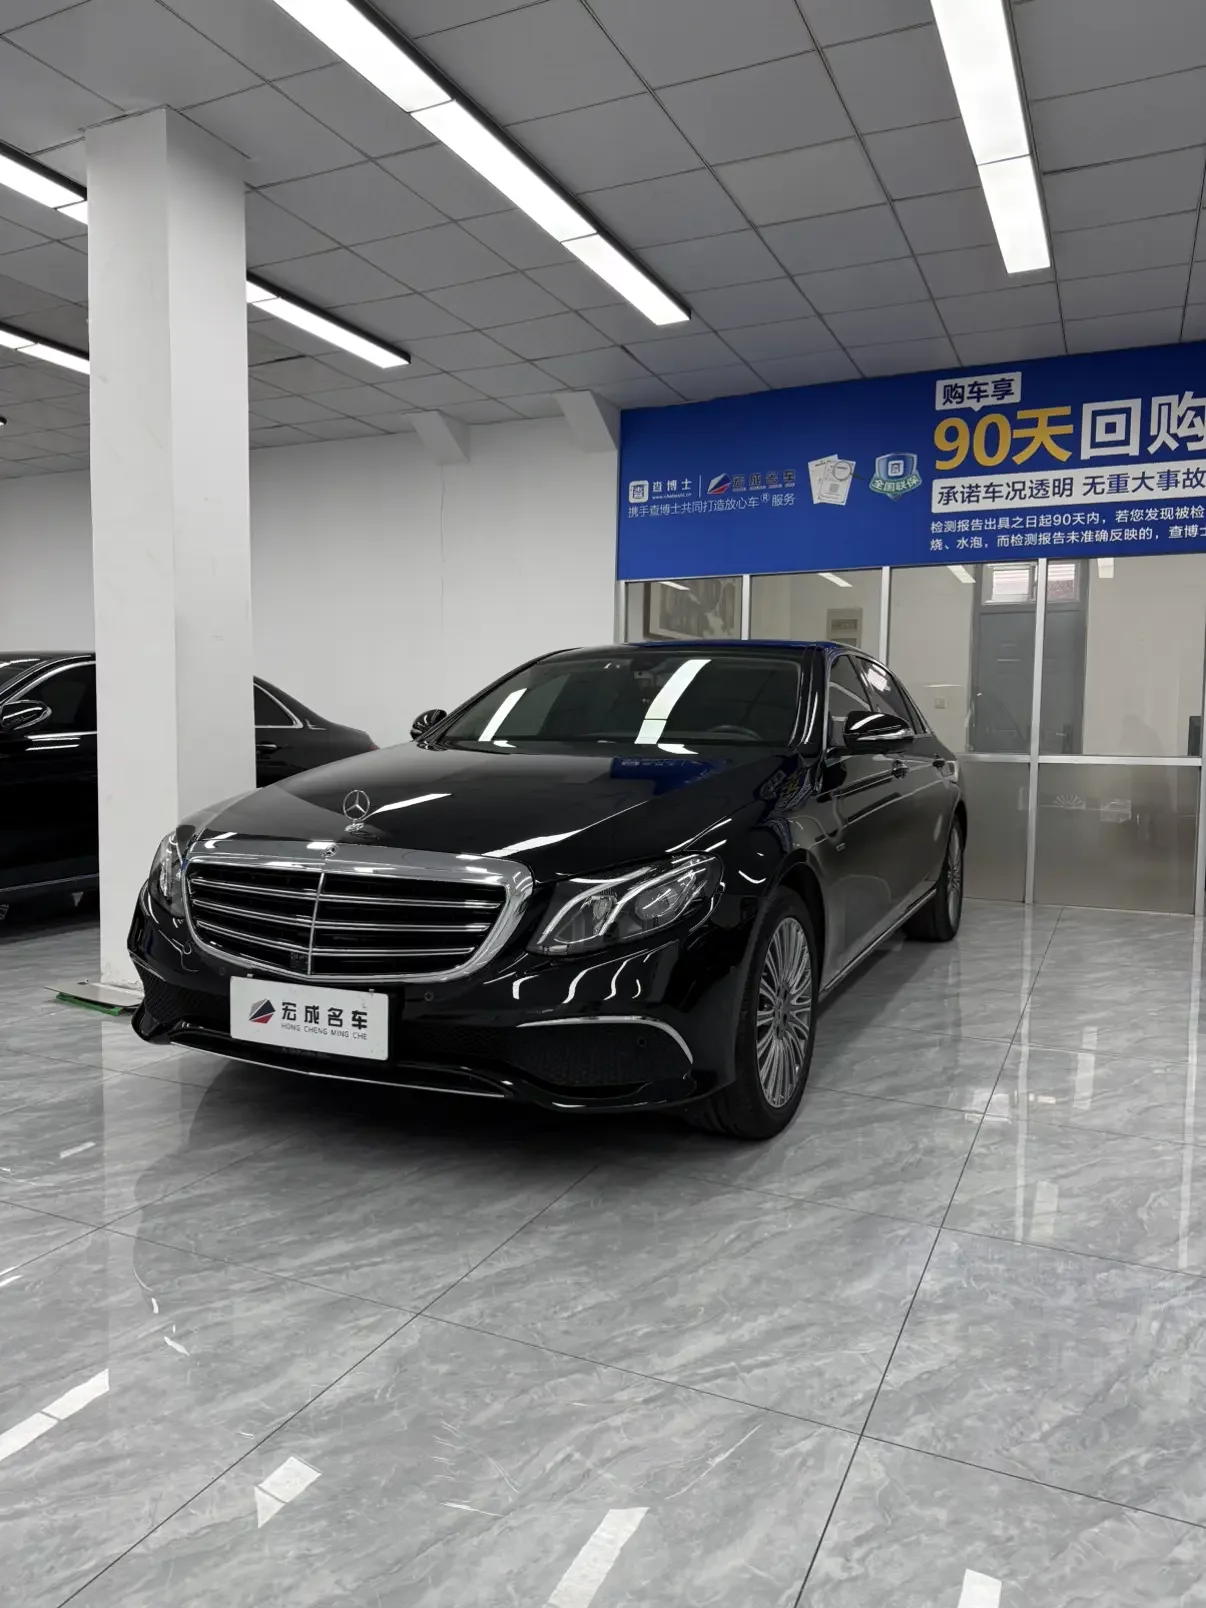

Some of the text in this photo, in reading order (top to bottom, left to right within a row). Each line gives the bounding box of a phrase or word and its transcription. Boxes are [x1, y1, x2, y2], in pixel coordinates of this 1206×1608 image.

[943, 378, 1014, 405] 购车享
[652, 478, 692, 492] 查博士
[871, 475, 920, 492] 全国联保
[937, 467, 1206, 505] 承诺车况透明 无重大事故
[281, 1001, 368, 1030] 宏成名车
[281, 1023, 368, 1040] HONG CHENG MING CHE
